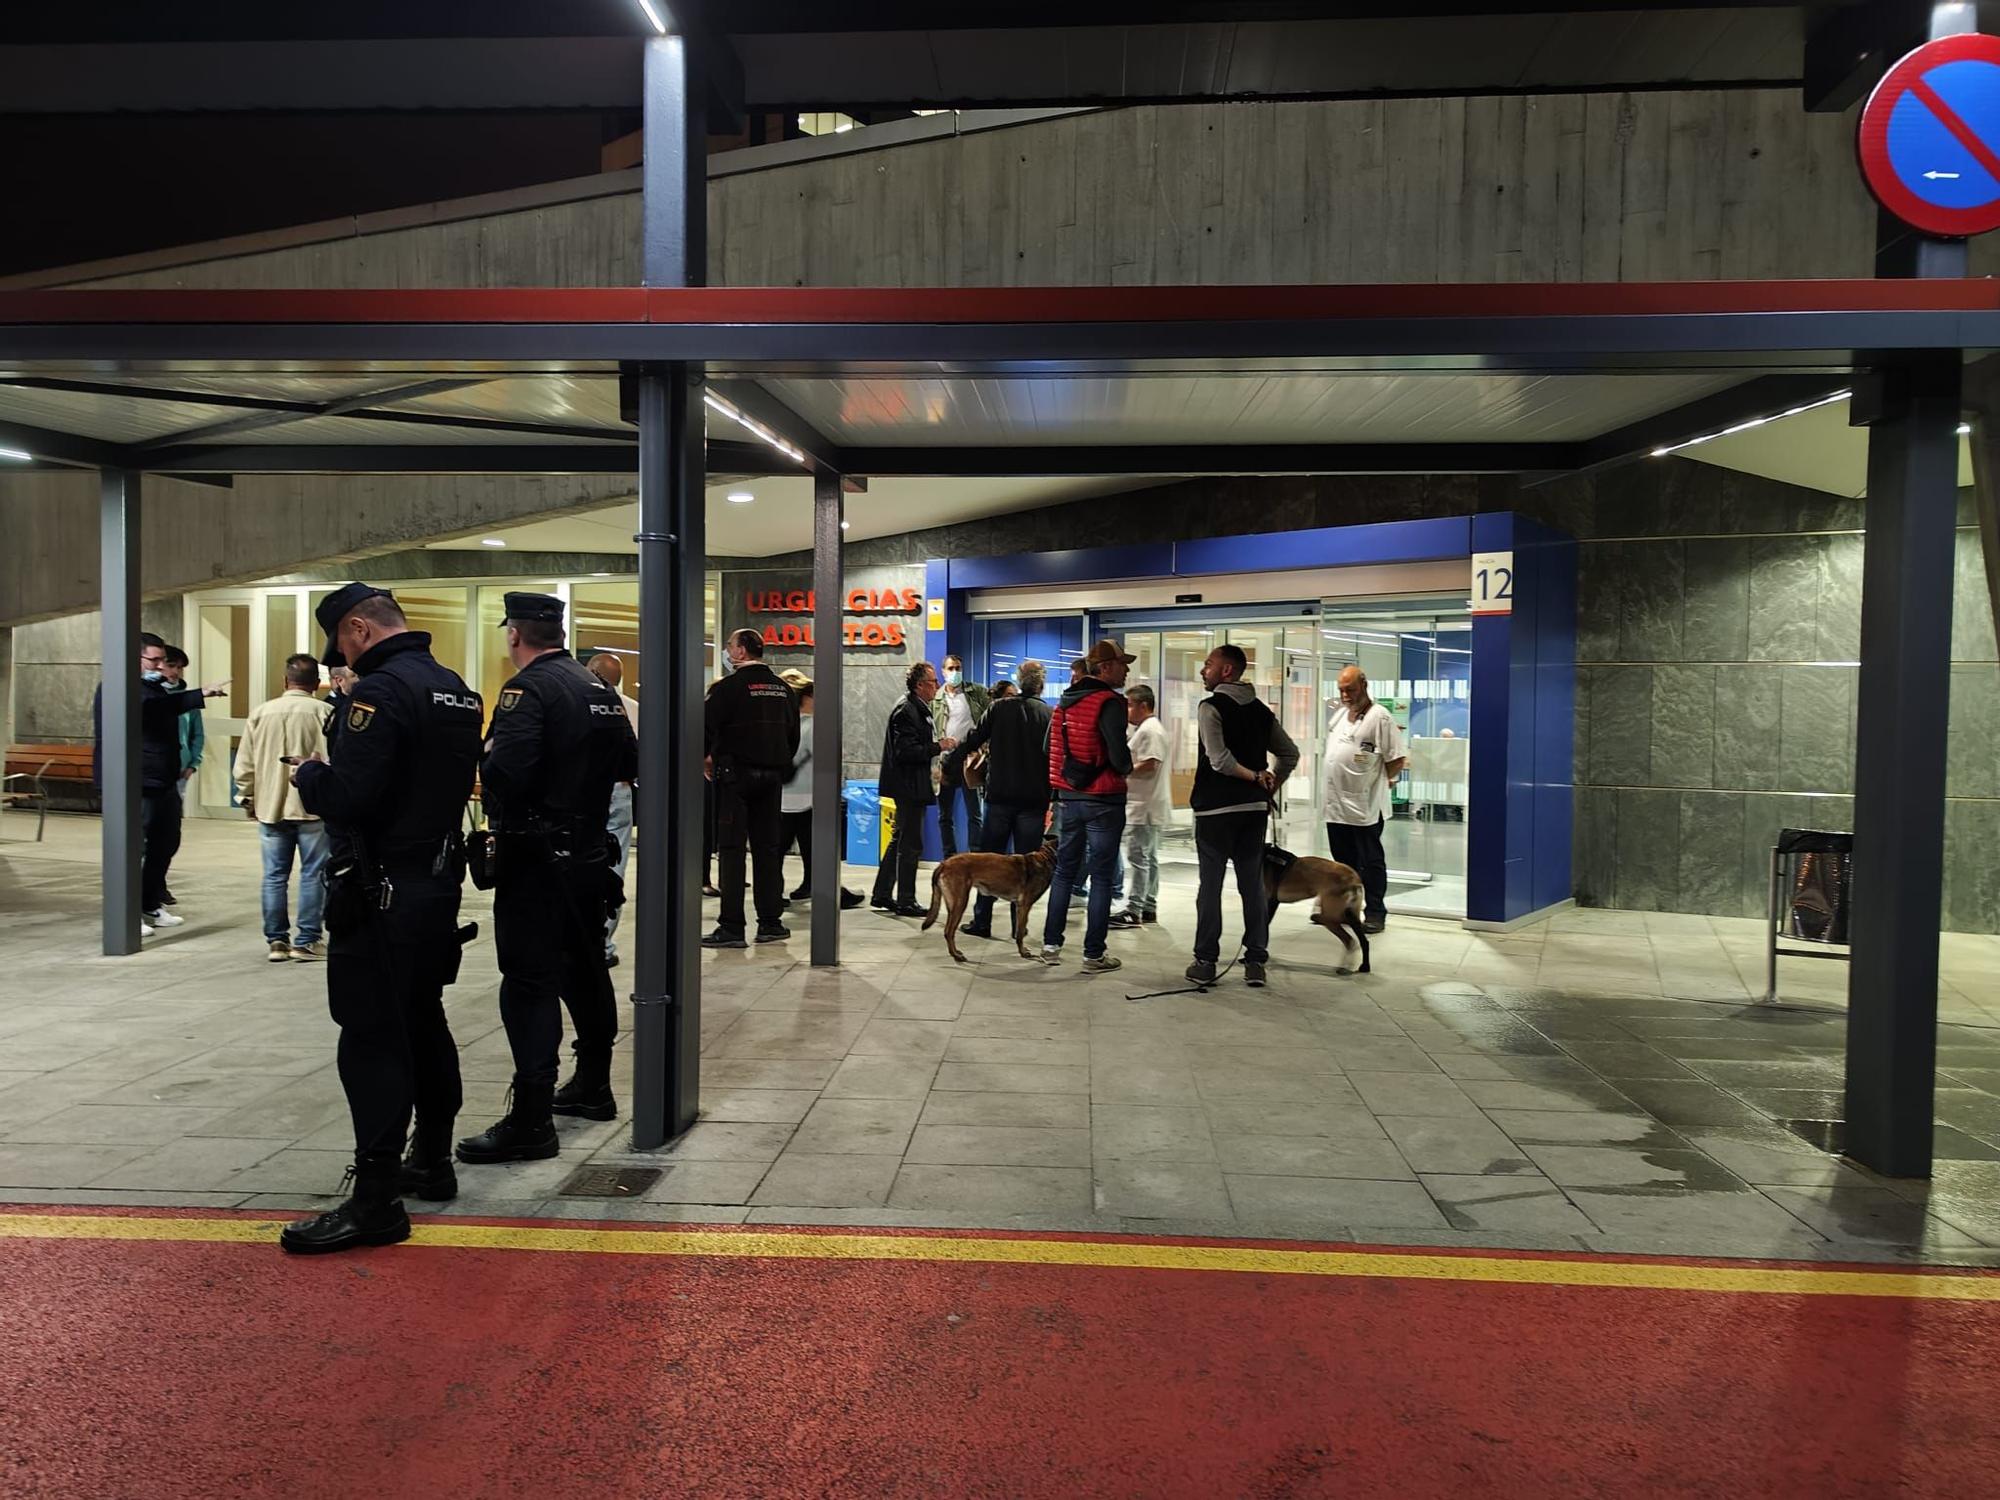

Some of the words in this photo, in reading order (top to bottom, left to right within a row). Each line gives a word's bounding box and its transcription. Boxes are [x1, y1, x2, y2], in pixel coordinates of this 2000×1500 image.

[1477, 567, 1512, 600] 12
[746, 588, 917, 611] URGCIAS
[763, 624, 902, 646] ADUTOS
